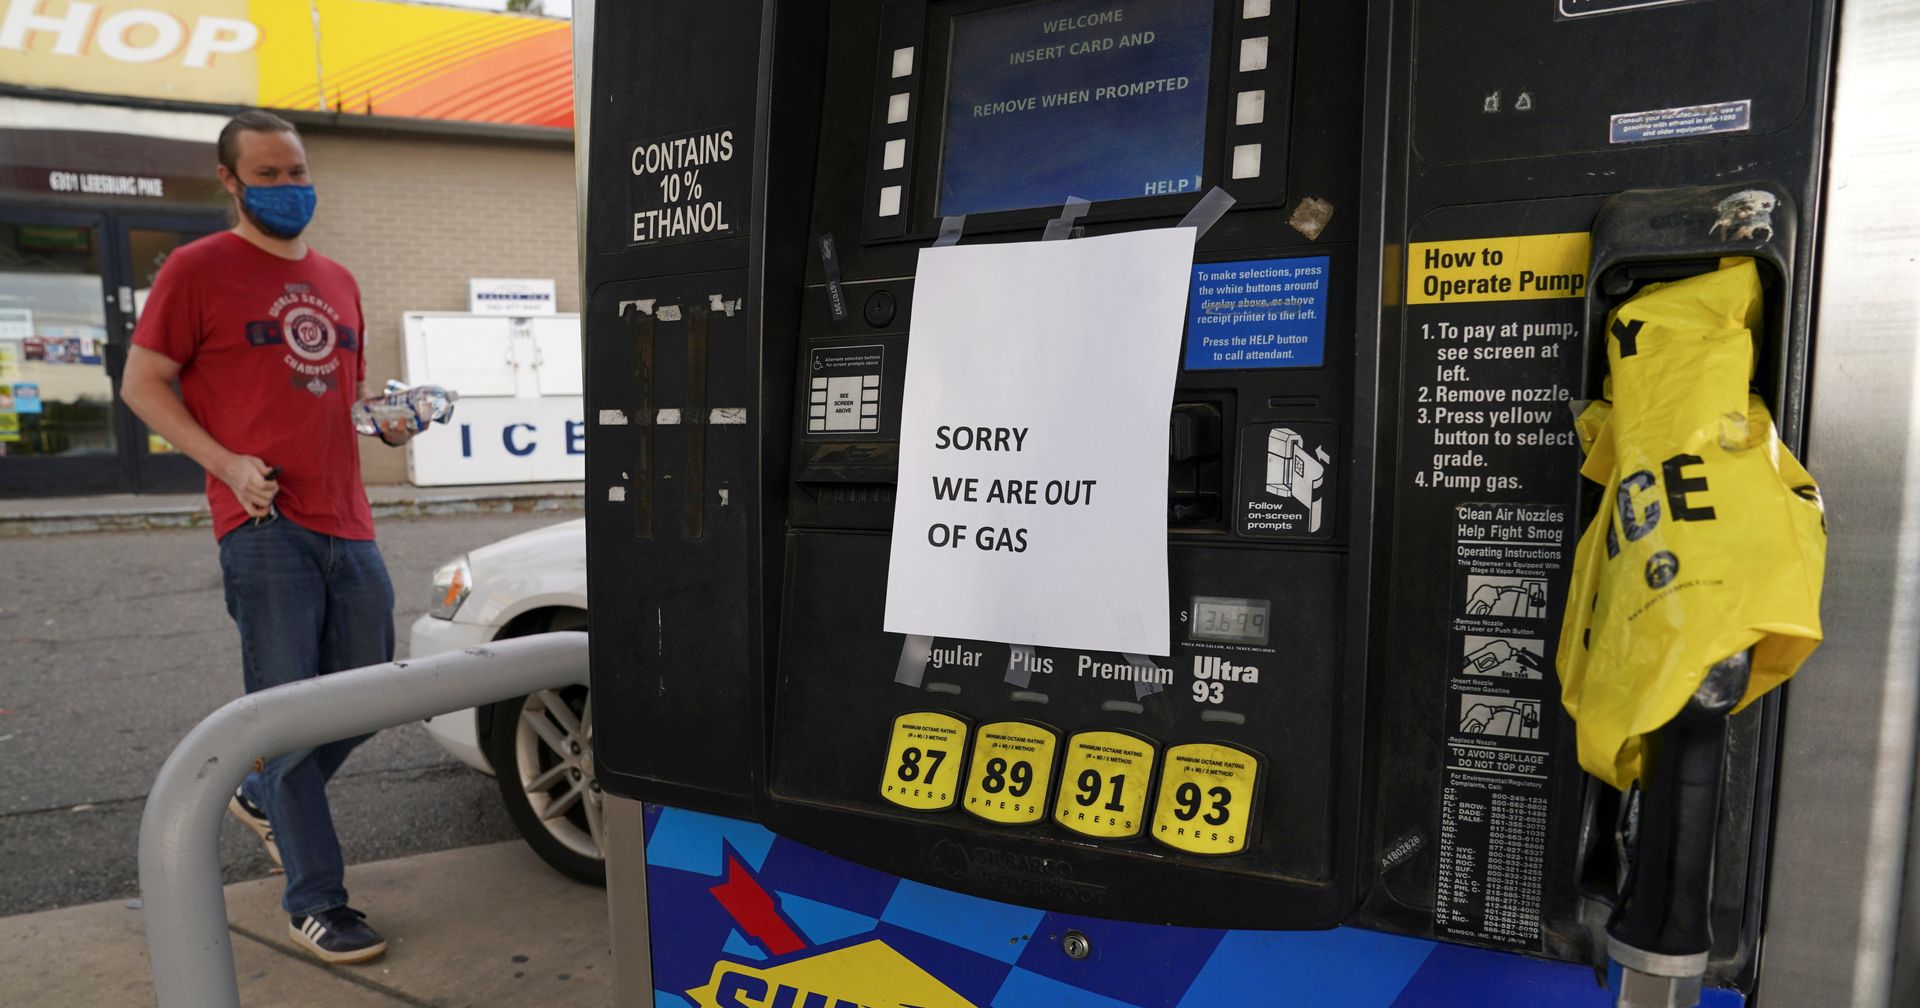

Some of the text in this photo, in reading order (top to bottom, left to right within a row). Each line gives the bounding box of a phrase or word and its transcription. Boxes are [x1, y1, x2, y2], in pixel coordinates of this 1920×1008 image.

[1043, 9, 1123, 34] WELCOME
[1009, 31, 1155, 65] INSERT CARD AND
[973, 76, 1189, 118] REMOVE WHEN PROMPTED
[632, 130, 733, 176] CONTAINS
[1144, 178, 1189, 195] HELP
[633, 201, 729, 241] ETHANOL
[1424, 247, 1503, 269] How to
[1198, 266, 1322, 281] To make selections, press
[1199, 280, 1319, 295] the white buttons around
[1424, 270, 1584, 301] Operate Pump
[268, 293, 341, 322] WORLD SERIES
[1285, 295, 1315, 306] above
[1197, 309, 1317, 326] receipt printer to the left.
[1203, 334, 1308, 347] Press the HELP button
[1421, 322, 1579, 343] 1. To pay at pump,
[1213, 349, 1294, 361] to call attendant.
[1437, 342, 1559, 361] see screen at
[284, 354, 340, 376] CHAMPIONS
[1437, 365, 1469, 382] left.
[1418, 384, 1574, 403] 2. Remove nozzle.
[1417, 406, 1552, 427] 3. Press yellow
[461, 420, 585, 457] ICE
[935, 425, 1029, 452] SORRY
[1434, 428, 1574, 446] button to select
[1433, 450, 1488, 470] grade.
[932, 476, 1097, 505] WE ARE OUT
[1414, 471, 1523, 493] 4. Pump gas.
[1248, 502, 1283, 510] Follow
[1458, 507, 1564, 522] Clean Air Nozzles
[1248, 512, 1302, 520] on-screen
[1247, 522, 1293, 531] prompts
[1458, 524, 1563, 542] Help Fight Smog
[928, 523, 1028, 553] OF GAS
[1457, 546, 1561, 559] Operating Instructions
[1470, 567, 1488, 575] Stage
[1515, 568, 1546, 576] Recovery
[1513, 561, 1543, 569] Equipped
[1180, 610, 1188, 622] $
[1009, 653, 1054, 674] Plus
[1078, 655, 1174, 685] Premium
[1193, 655, 1259, 684] Ultra
[1192, 681, 1224, 704] 93
[1079, 743, 1143, 758] MINIMUM OCTANE RATING
[1452, 747, 1544, 765] TO AVOID SPILLAGE
[898, 747, 947, 785] 87
[1176, 755, 1245, 770] MINIMUM OCTANE RATING
[1458, 758, 1537, 774] DO NOT TOP OFF
[981, 757, 1033, 798] 89
[887, 785, 947, 801] PRESS
[1075, 768, 1126, 813] 91
[970, 797, 1035, 814] PRESS
[1174, 781, 1232, 826] 93
[1063, 809, 1132, 829] PRESS
[1160, 825, 1235, 844] PRESS
